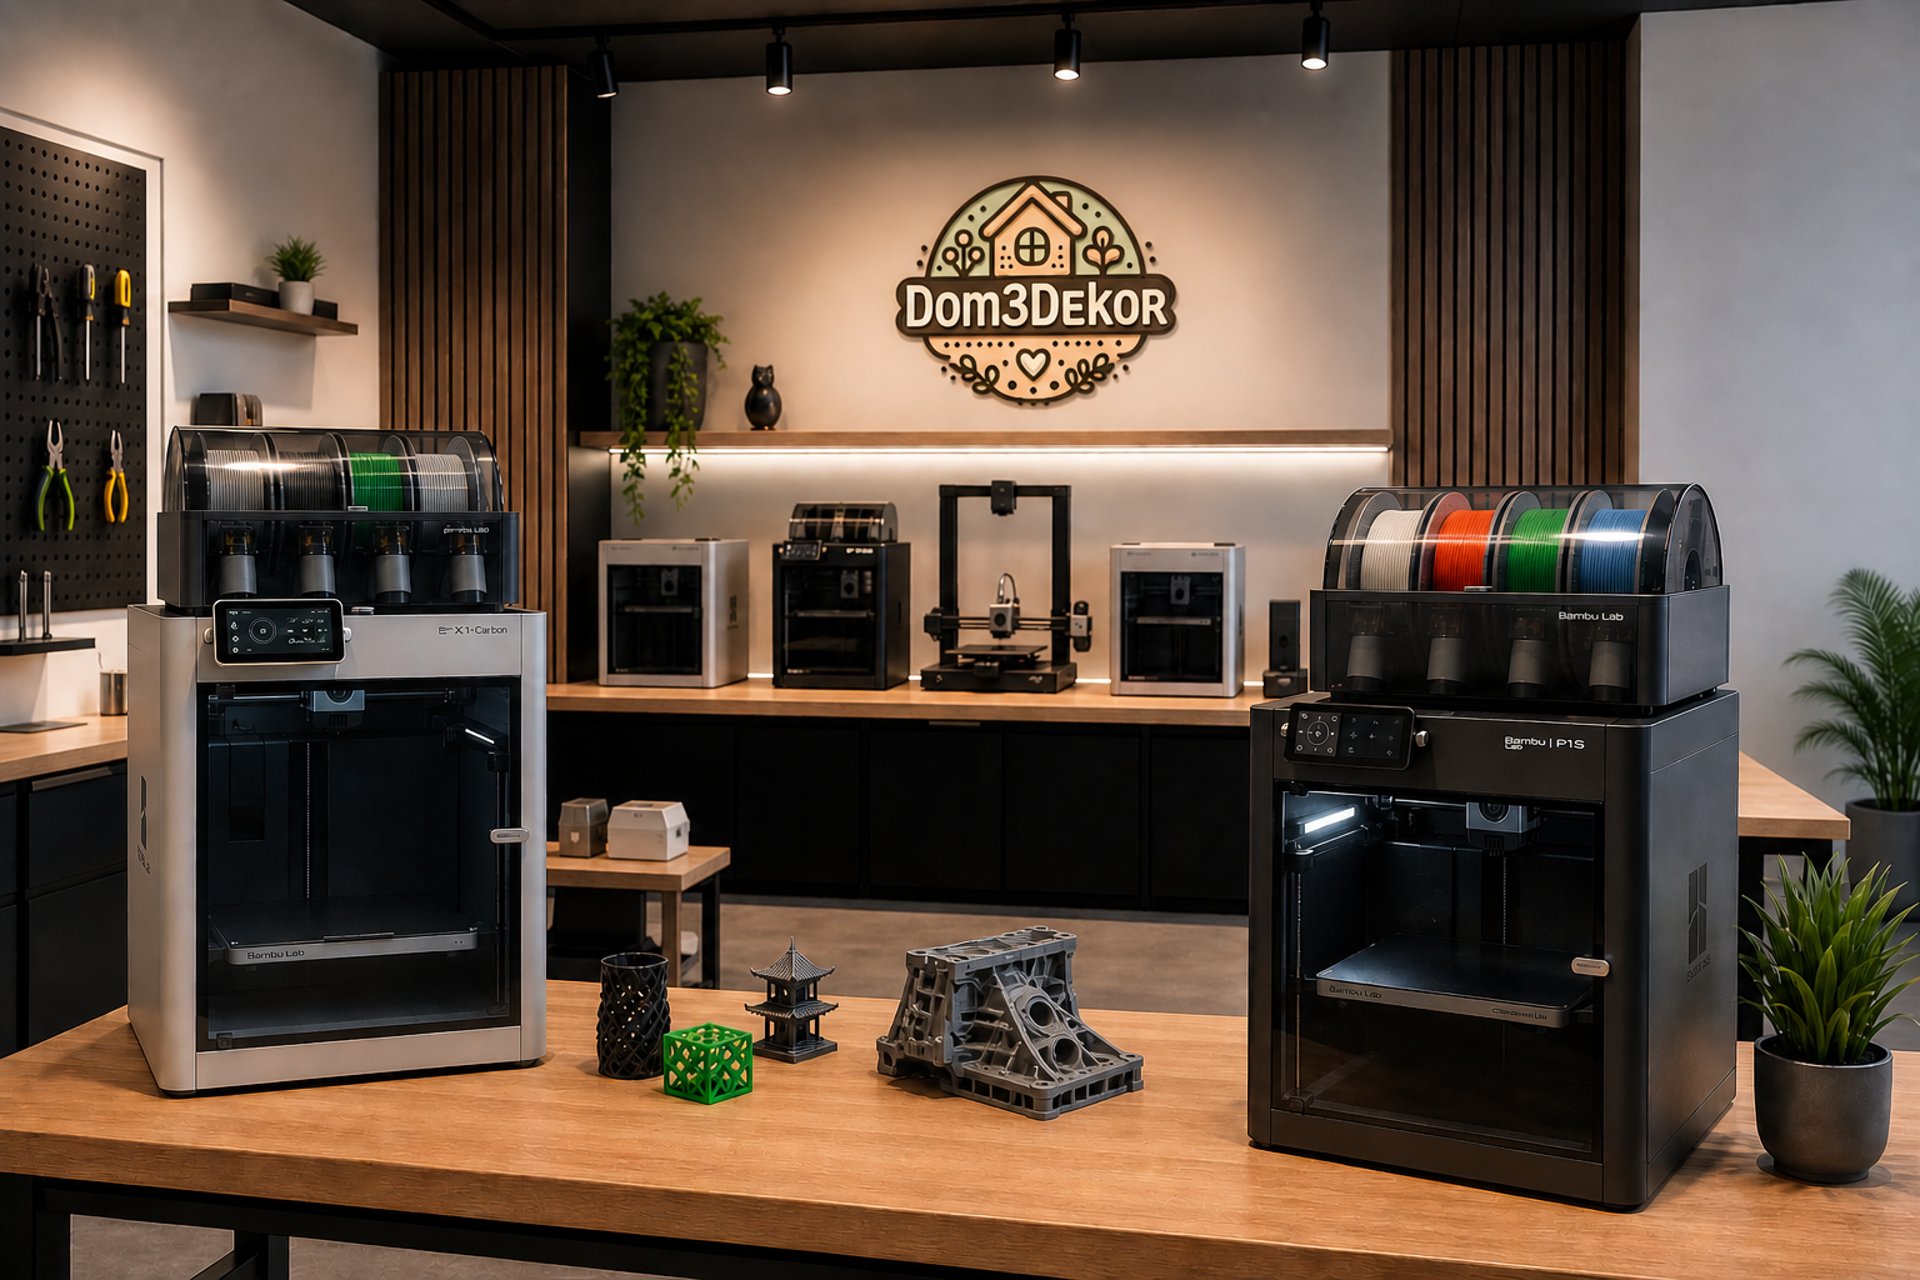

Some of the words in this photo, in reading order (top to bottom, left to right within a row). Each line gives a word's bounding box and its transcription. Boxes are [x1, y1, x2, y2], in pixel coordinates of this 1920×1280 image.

[1558, 611, 1599, 620] Bambu
[1602, 612, 1624, 621] Lab
[1504, 736, 1546, 746] Bambu
[1556, 739, 1585, 749] P1S
